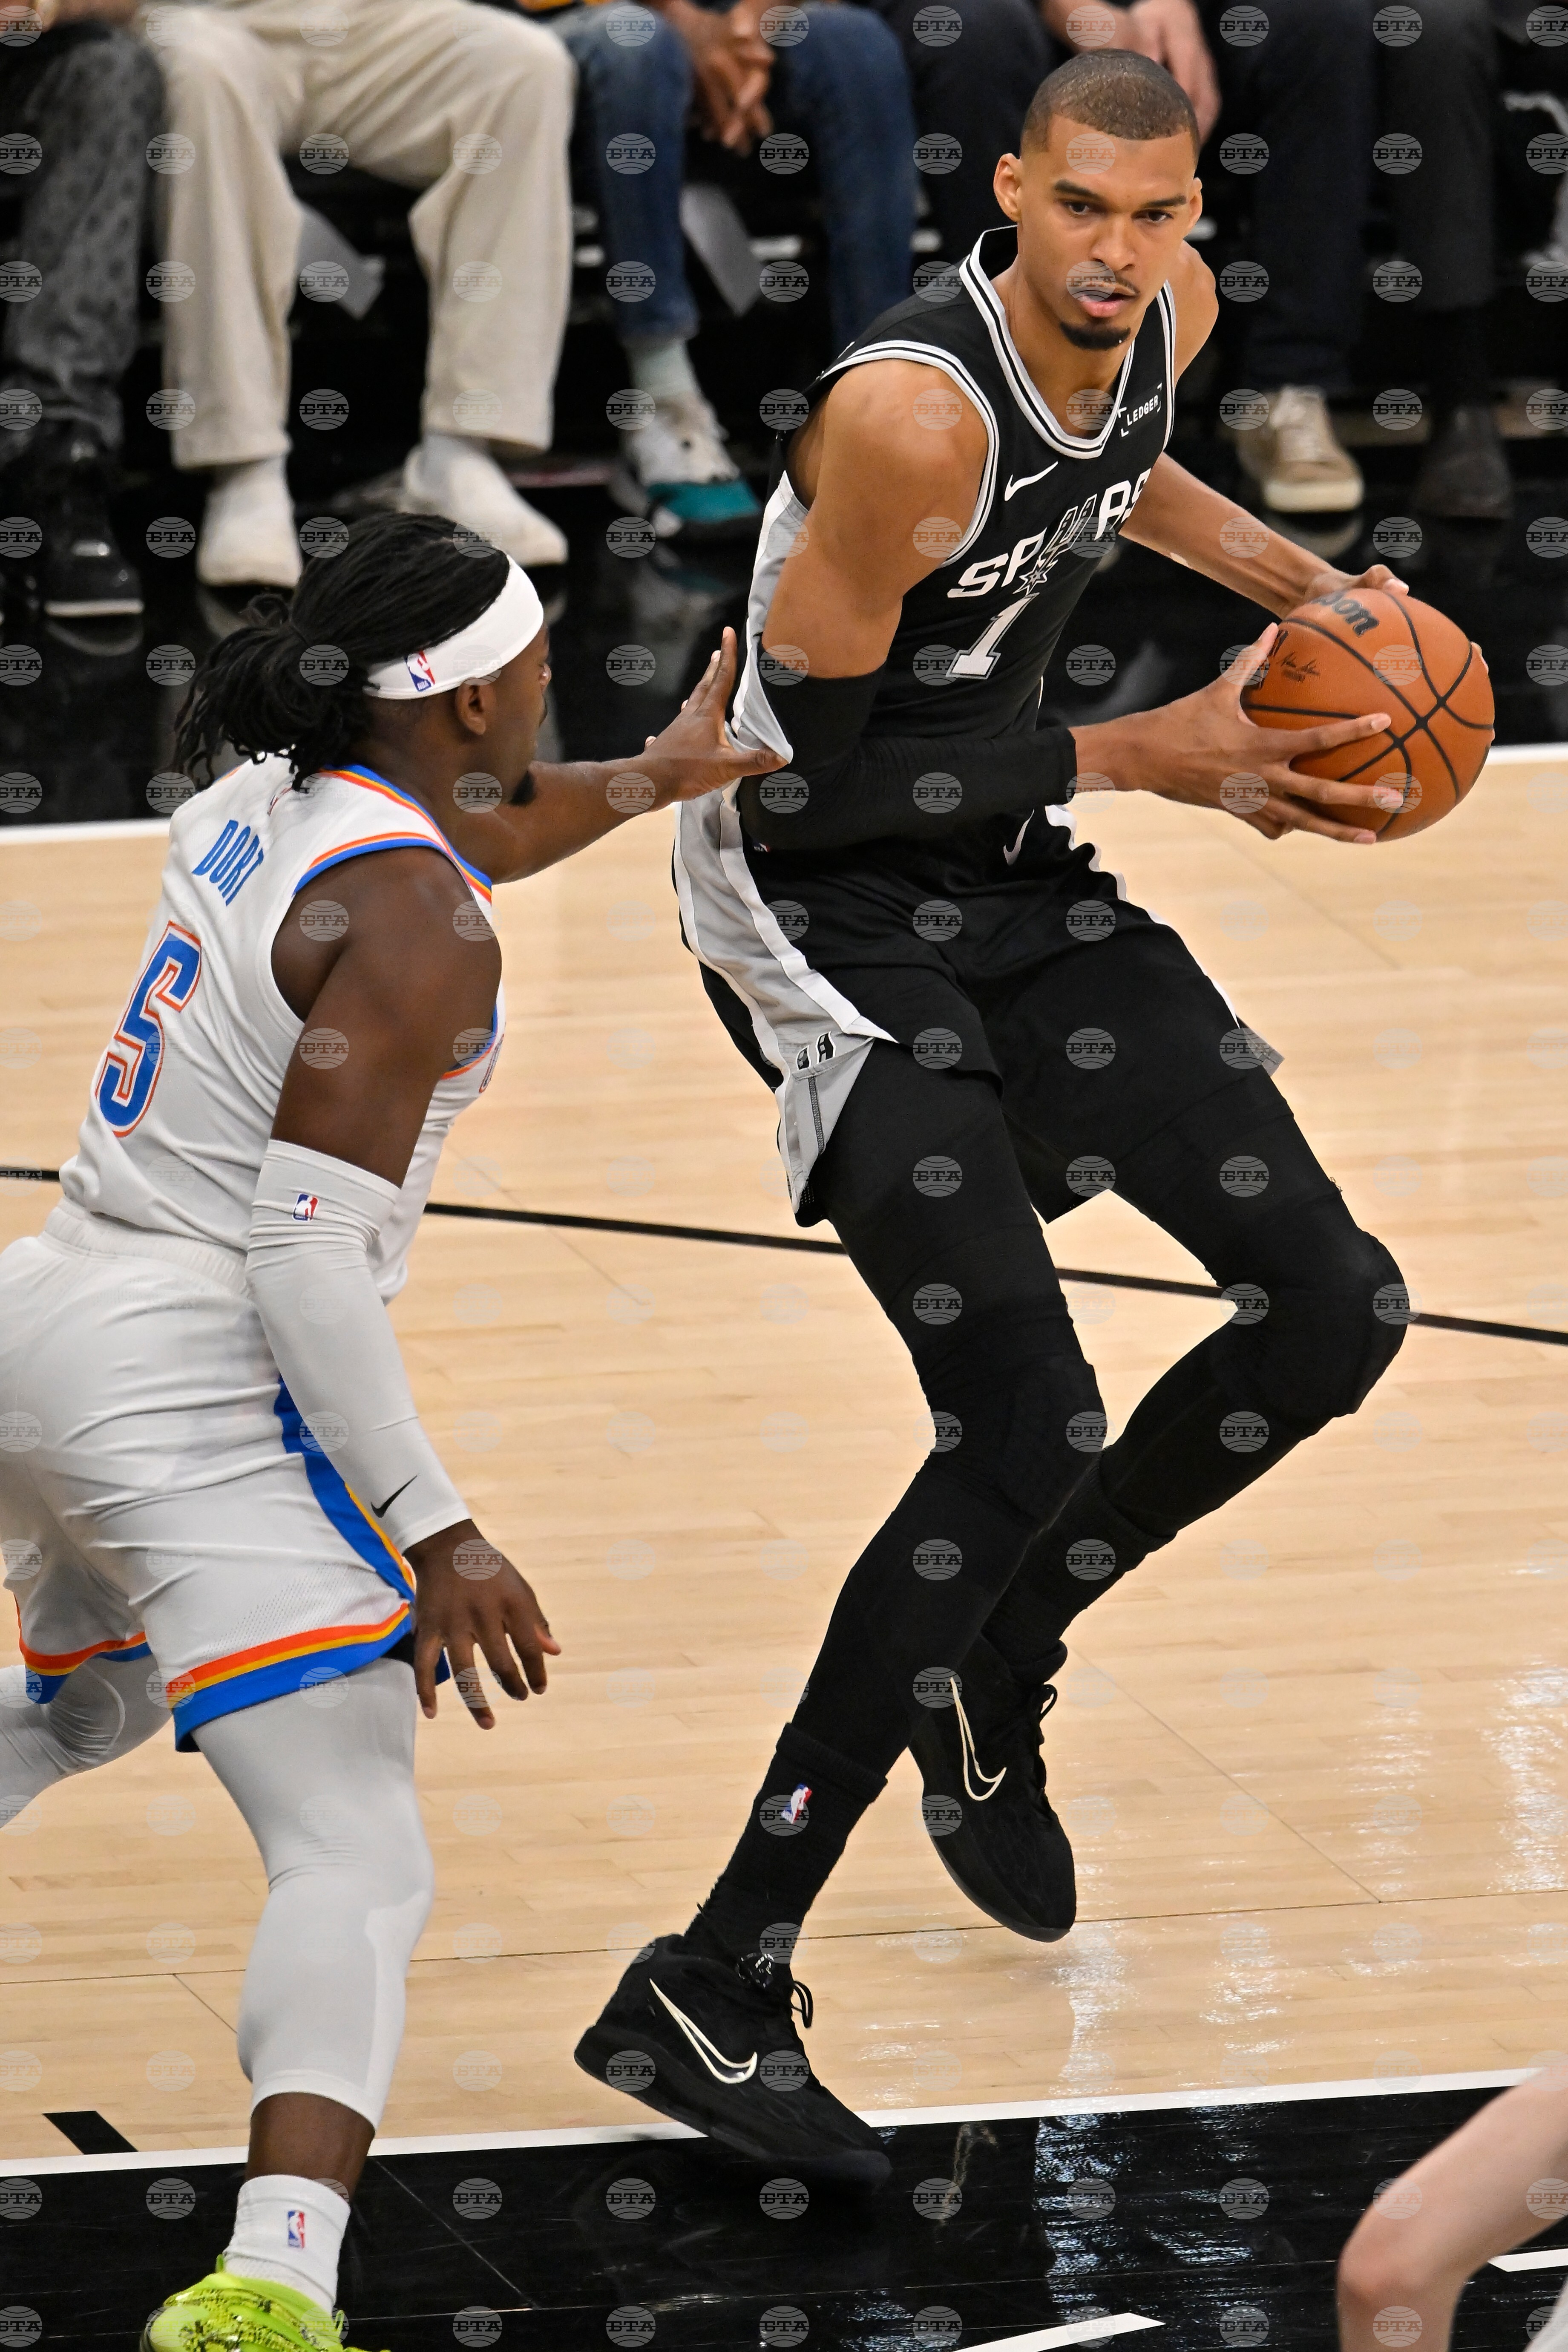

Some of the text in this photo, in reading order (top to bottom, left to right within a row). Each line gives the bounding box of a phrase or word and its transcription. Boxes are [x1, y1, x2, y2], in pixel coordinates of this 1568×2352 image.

[1127, 394, 1158, 426] LEDGER
[947, 468, 1151, 598] SPURS
[946, 592, 1040, 679] 1
[192, 820, 264, 907] DORT
[95, 920, 202, 1138] 5
